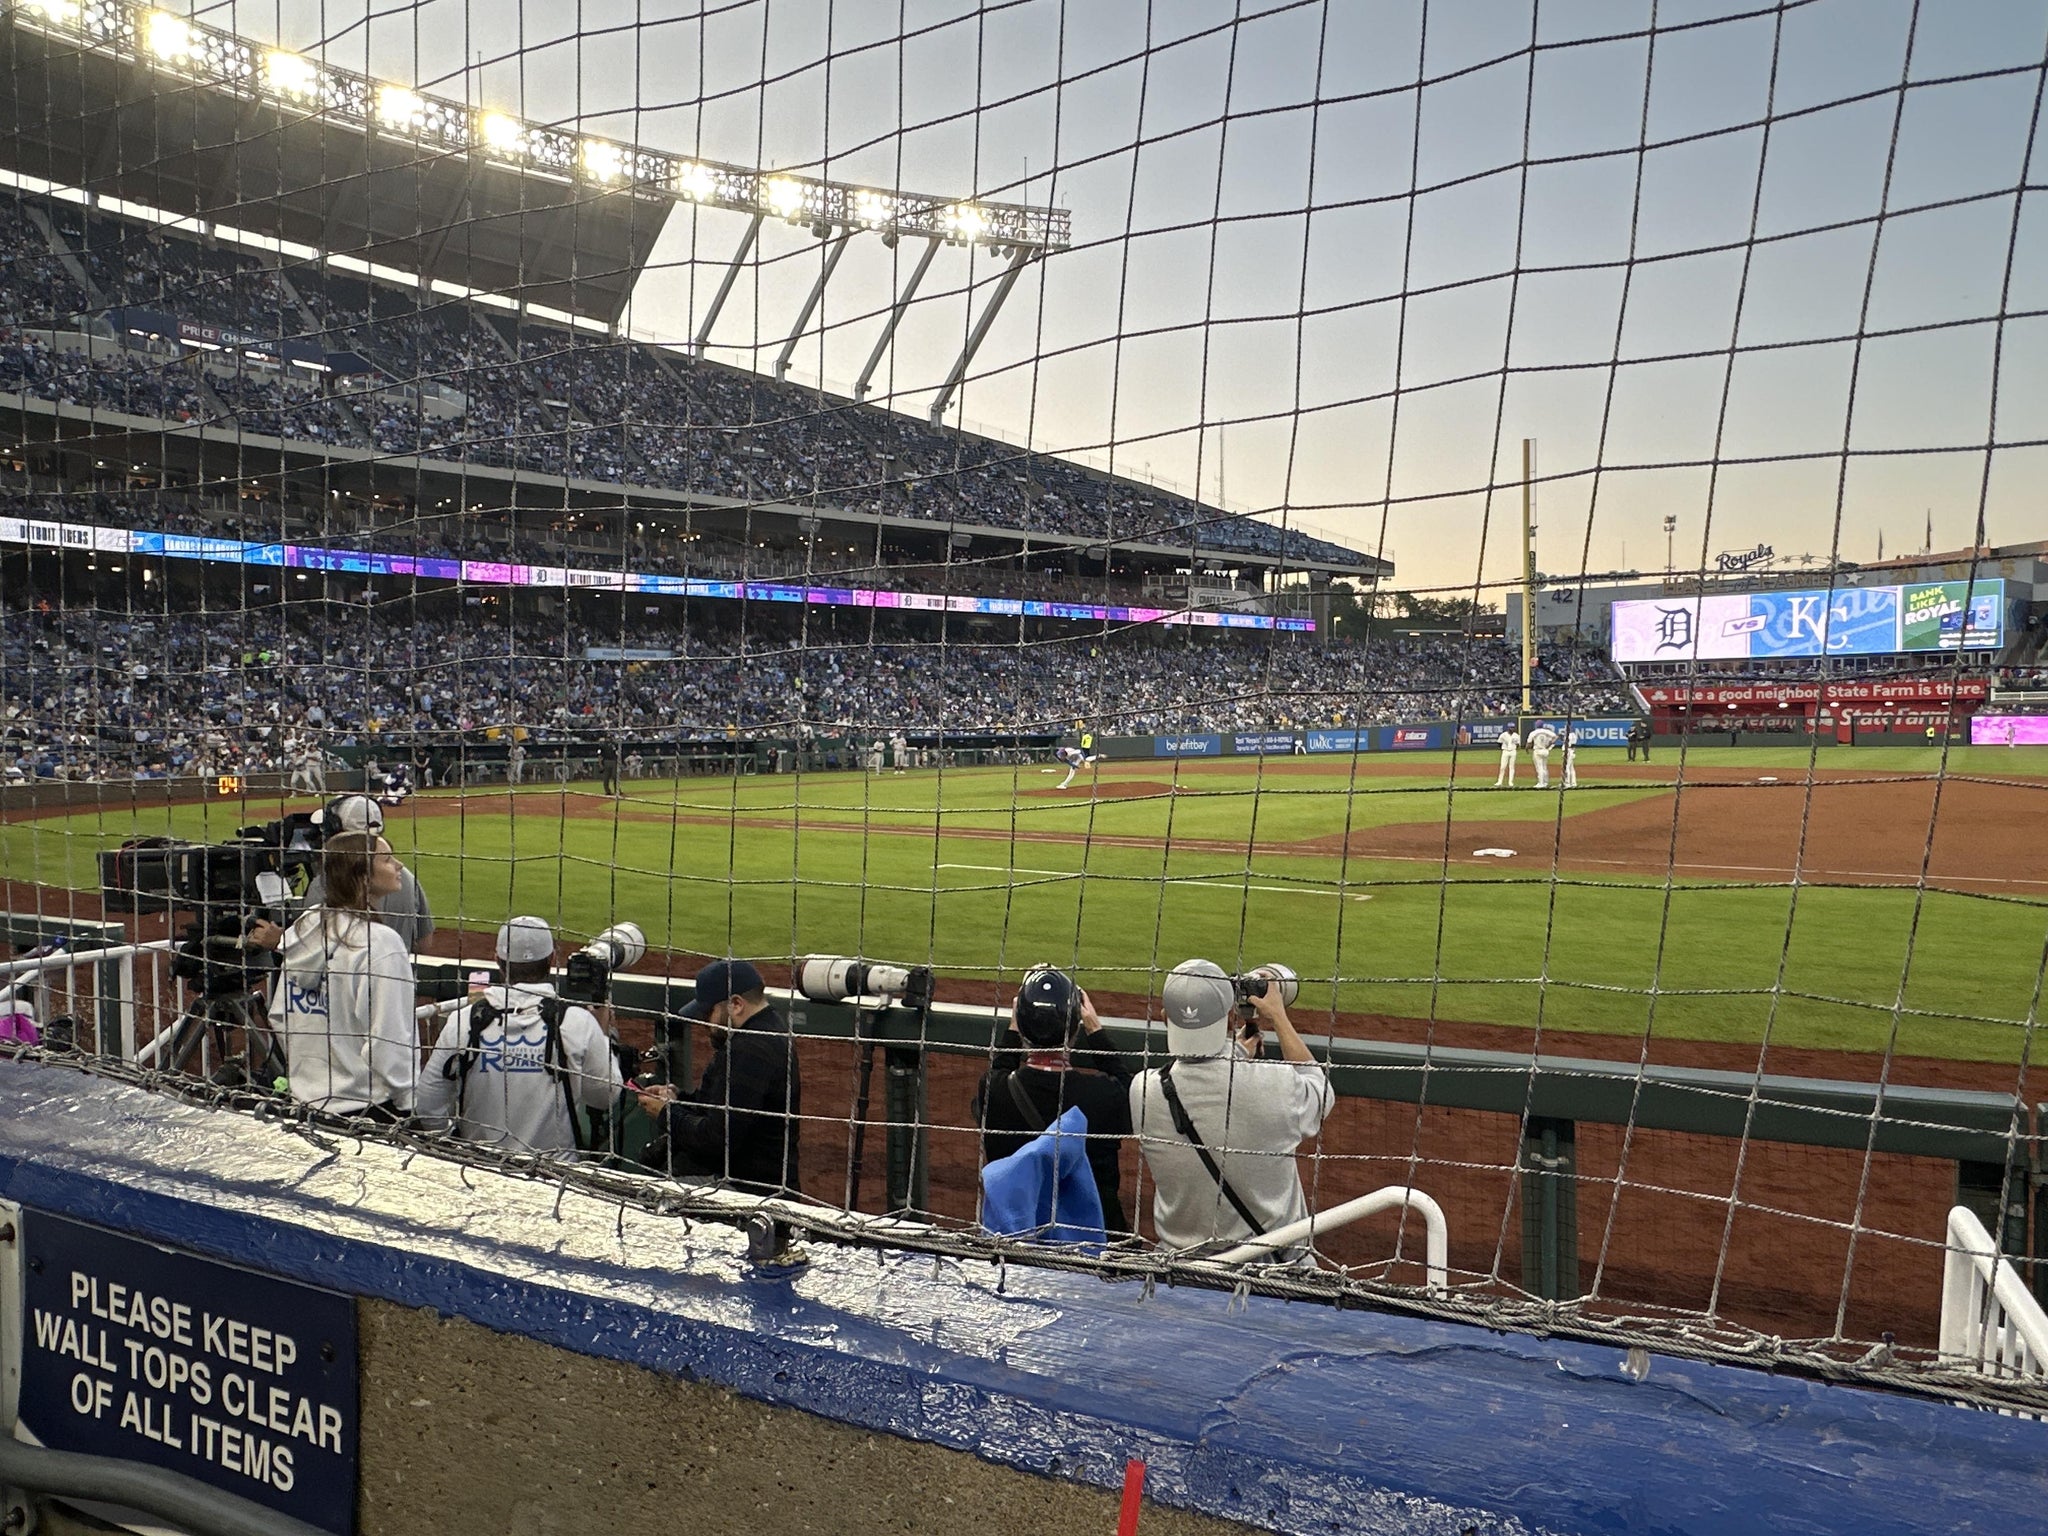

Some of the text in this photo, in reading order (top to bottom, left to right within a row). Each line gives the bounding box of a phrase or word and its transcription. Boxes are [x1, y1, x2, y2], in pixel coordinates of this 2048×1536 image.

[20, 525, 89, 545] DTROIT IGERS
[1715, 543, 1775, 570] Royals
[1551, 588, 1574, 603] 42
[1910, 586, 1944, 602] BANK
[1910, 595, 1948, 612] LIKE A
[1905, 600, 1962, 625] ROYAL
[1707, 692, 1715, 700] a
[1719, 687, 1752, 702] good
[1827, 686, 1868, 697] State
[1873, 685, 1914, 696] Farm
[1918, 683, 1932, 695] is
[71, 1271, 297, 1376] PLEASE KEEP
[34, 1308, 343, 1454] WALL TOPS CLEAR
[71, 1372, 295, 1493] OF ALL ITEMS
